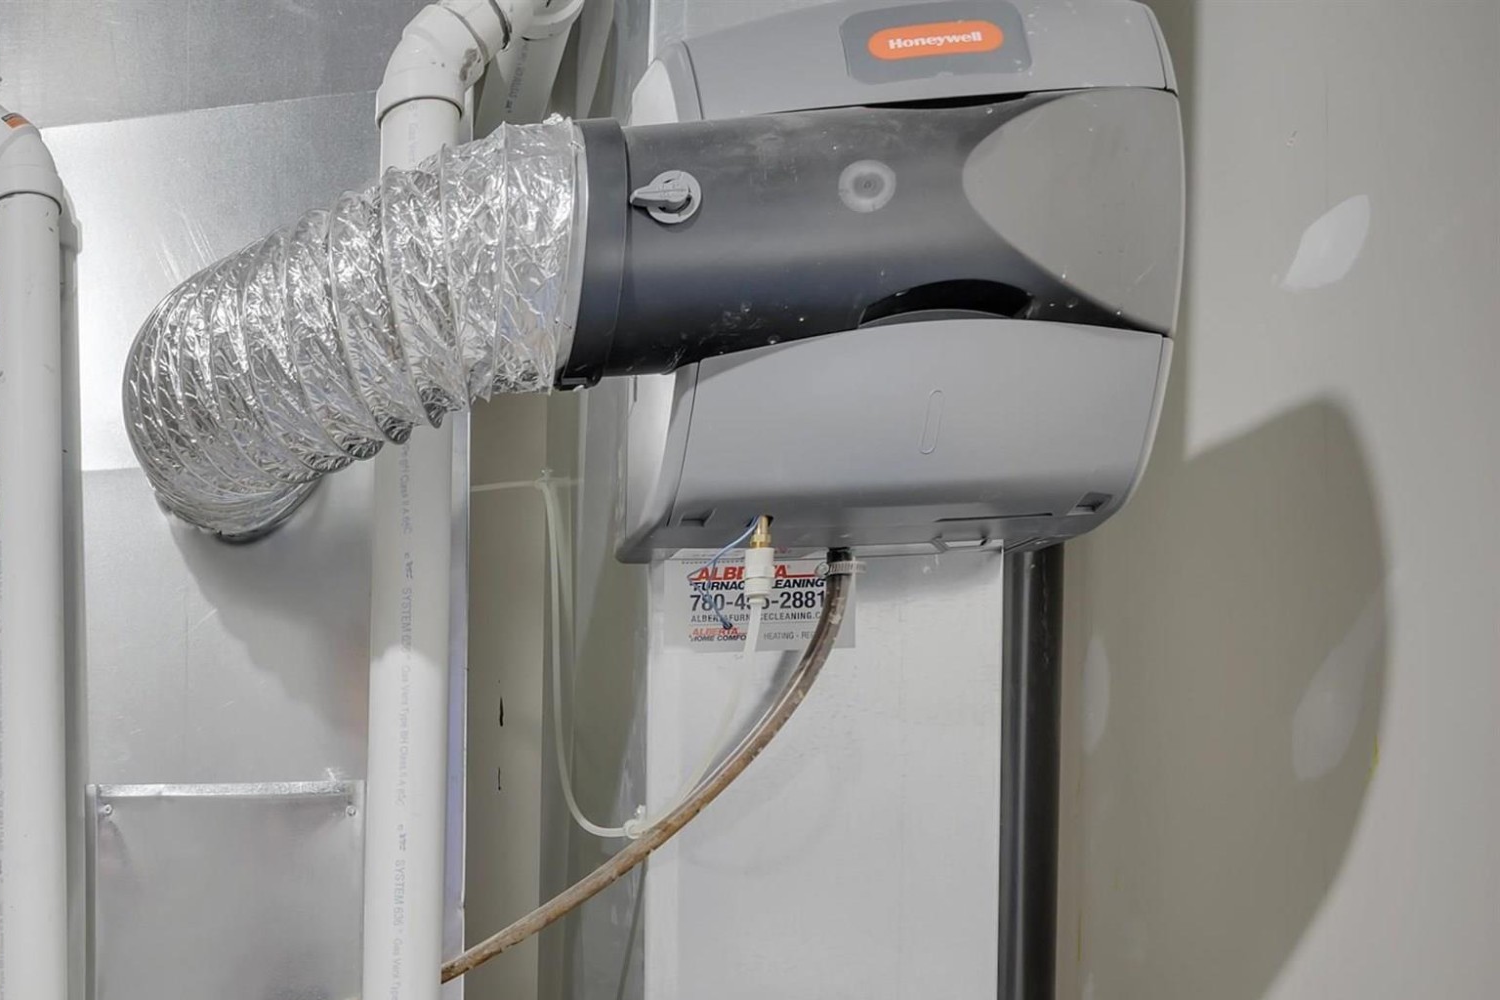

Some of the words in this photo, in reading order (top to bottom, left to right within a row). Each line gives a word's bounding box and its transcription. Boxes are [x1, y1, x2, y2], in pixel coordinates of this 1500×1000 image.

[888, 31, 982, 49] Honeywell
[692, 581, 745, 591] FURNAC
[401, 588, 412, 632] SYSTEM
[764, 632, 793, 640] HEATING
[394, 860, 405, 905] SYSTEM
[393, 907, 403, 926] 636
